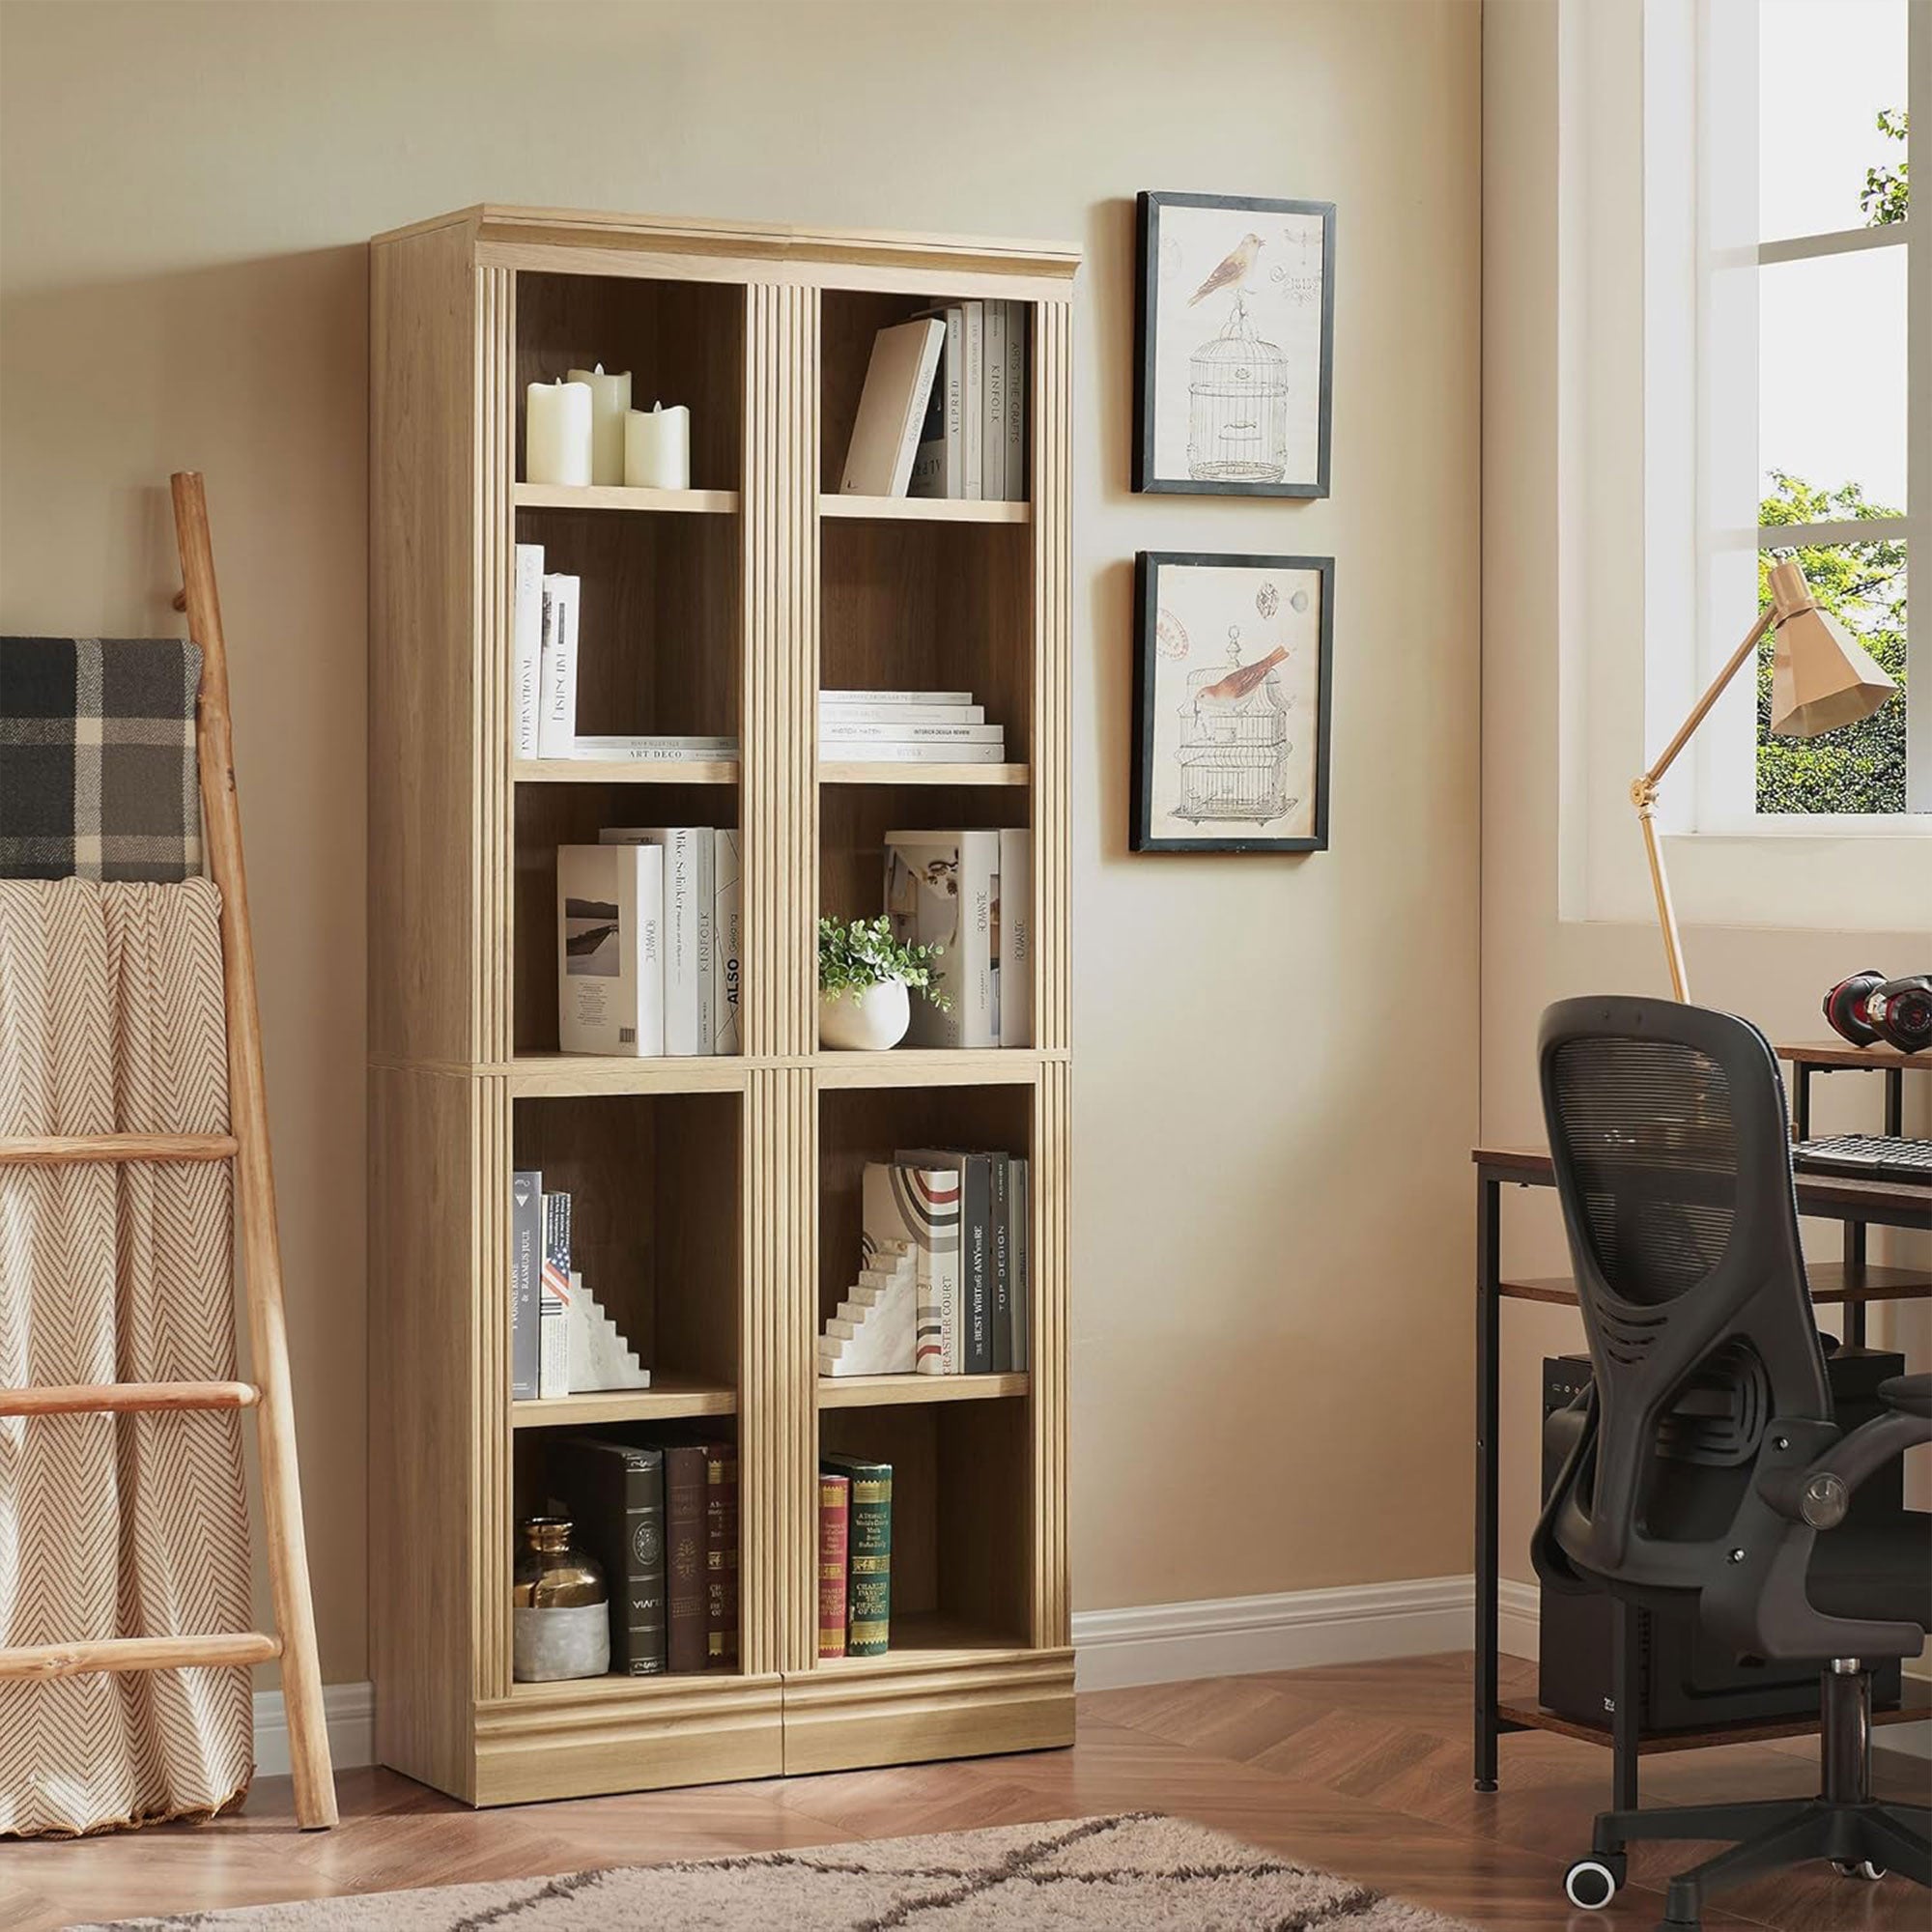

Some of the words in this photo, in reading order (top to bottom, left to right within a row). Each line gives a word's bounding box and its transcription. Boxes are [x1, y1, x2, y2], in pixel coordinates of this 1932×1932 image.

[1011, 342, 1020, 370] ARTS
[990, 364, 1000, 423] KINFOLK
[1011, 376, 1020, 397] THE
[1010, 402, 1019, 444] CRAFTS
[522, 657, 532, 751] INTERNATIONAL
[675, 830, 687, 857] Mike
[977, 892, 987, 932] ROMANTIC
[700, 911, 709, 973] KINFOLK
[726, 958, 740, 1005] ALSO
[522, 1230, 530, 1252] JUUL
[997, 1225, 1006, 1277] DESIGN
[942, 1276, 952, 1317] COURT
[942, 1319, 952, 1375] CRASTER
[974, 1315, 982, 1341] BEST
